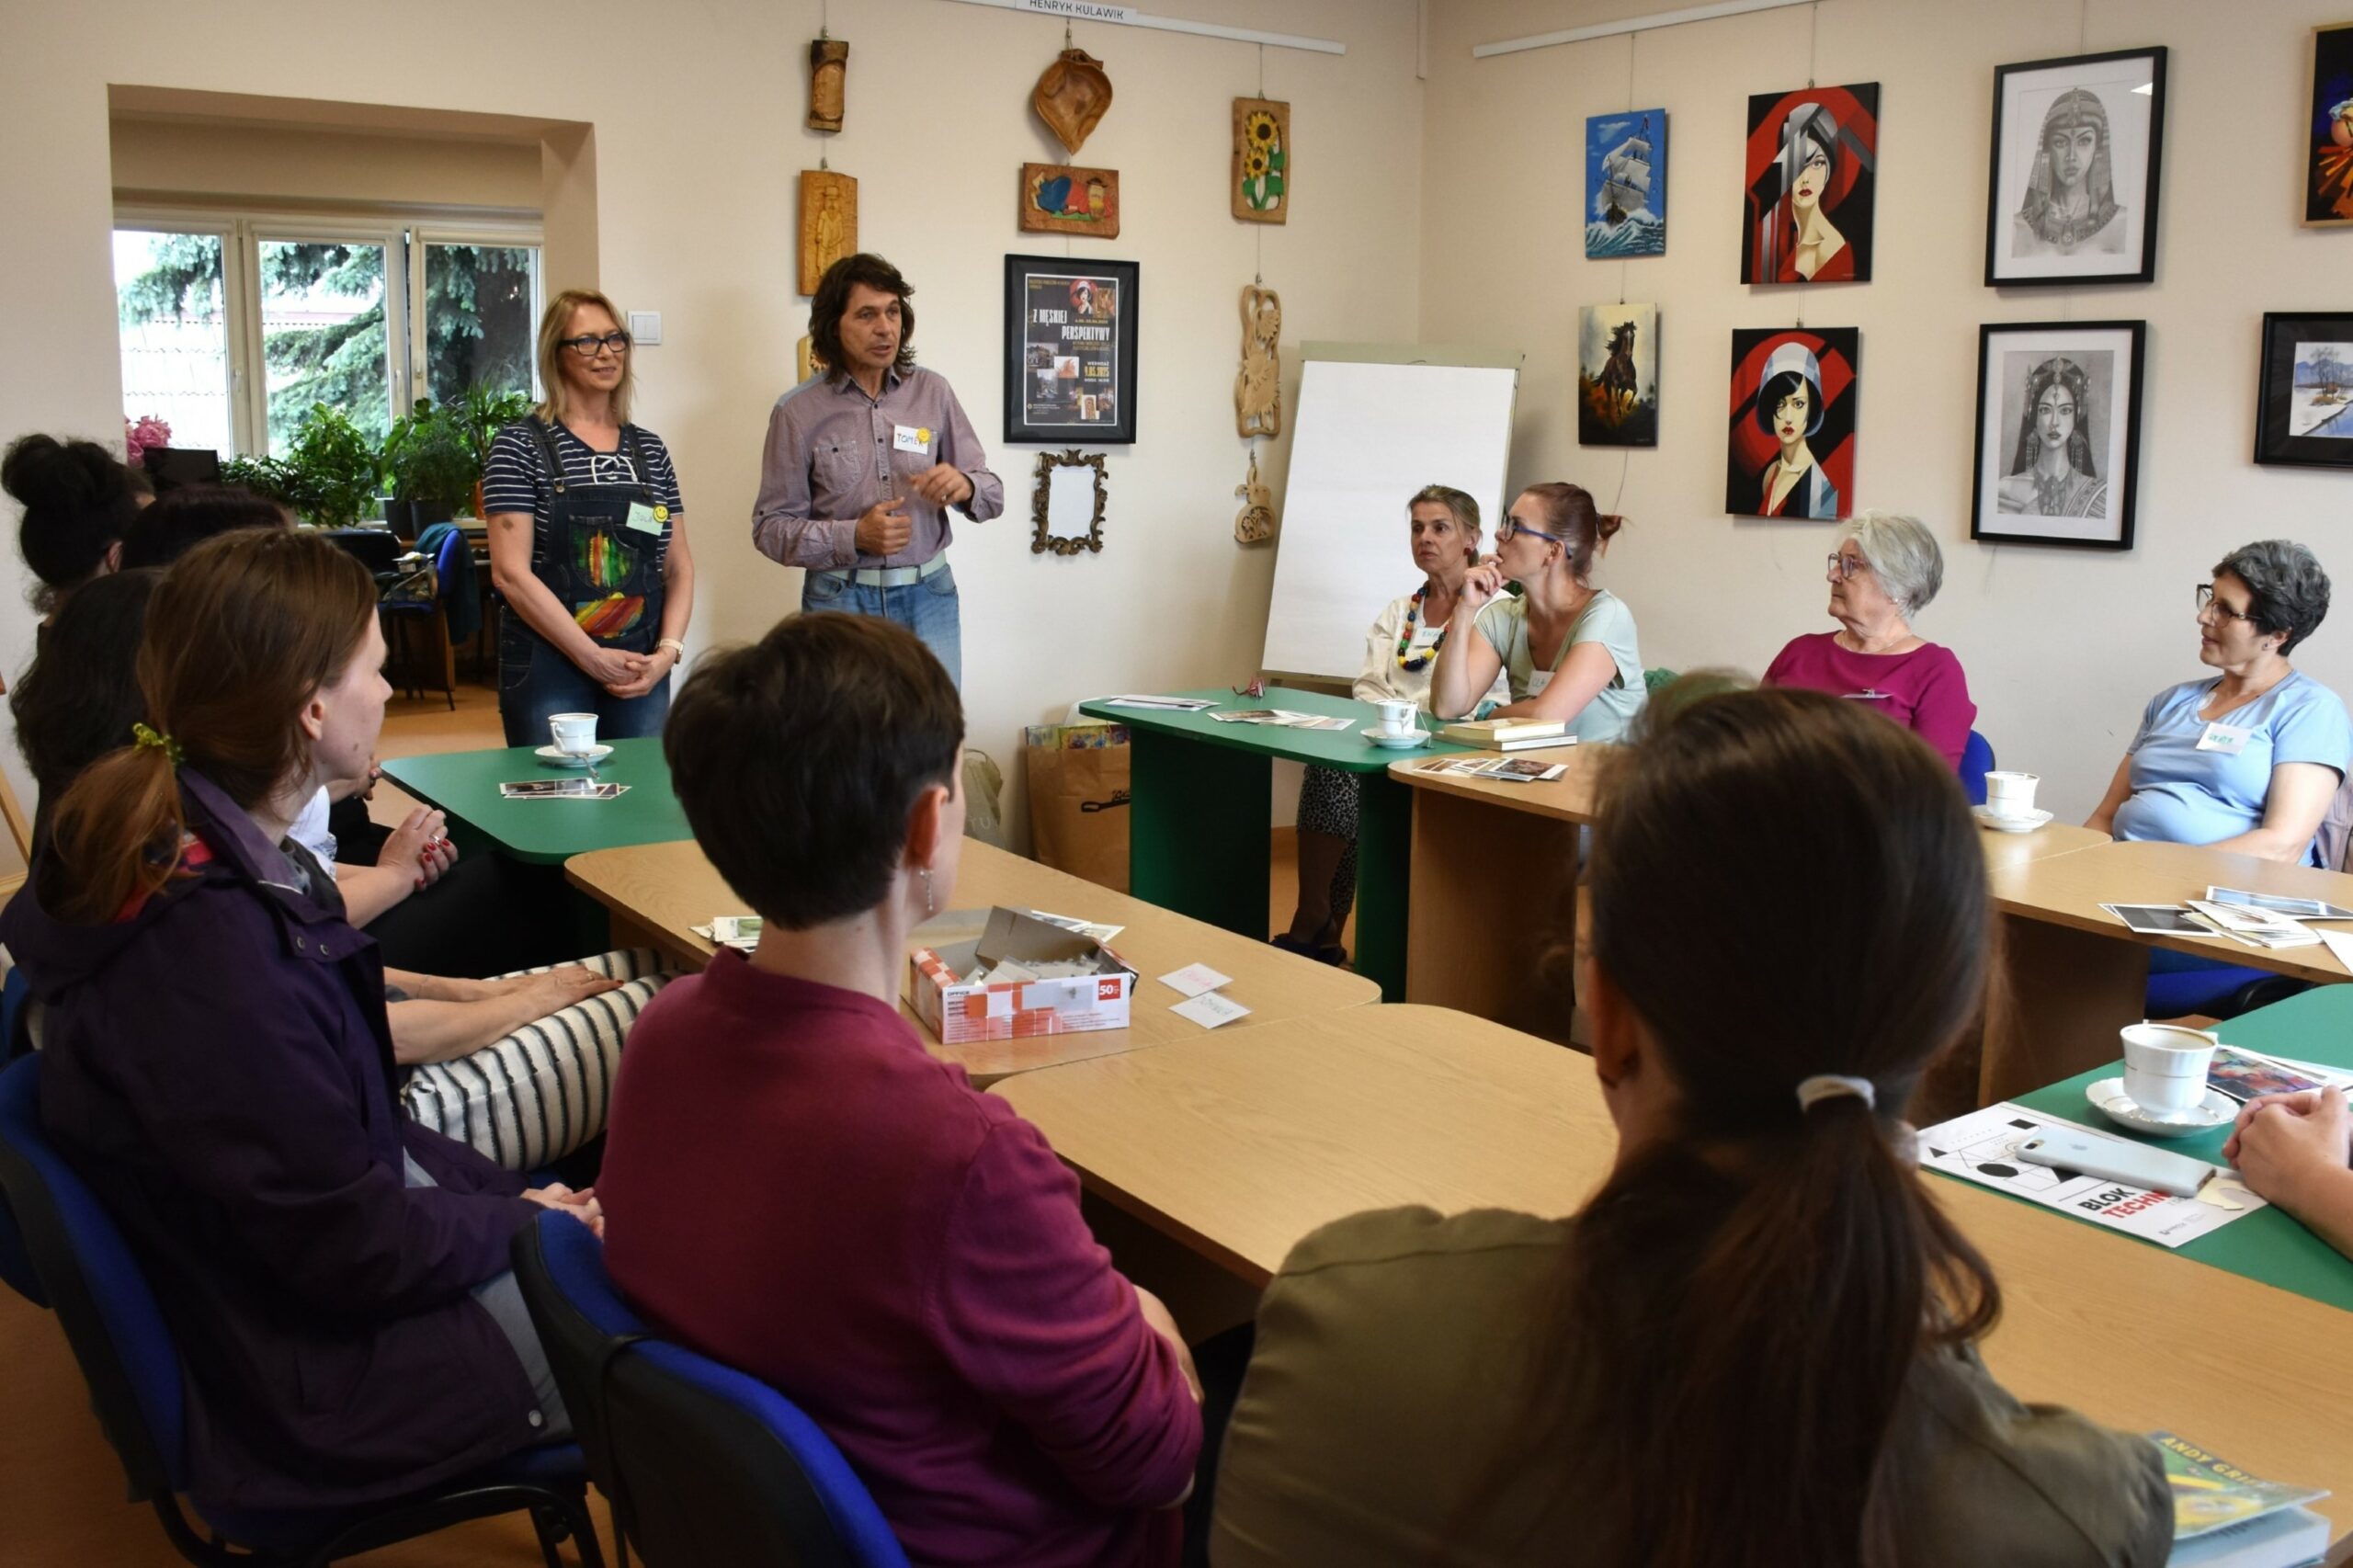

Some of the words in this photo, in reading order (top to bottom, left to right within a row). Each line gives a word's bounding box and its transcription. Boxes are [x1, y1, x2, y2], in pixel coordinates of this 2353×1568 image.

[1029, 0, 1073, 12] HENRYK
[1075, 4, 1124, 19] KULAWIK
[1032, 309, 1038, 324] Z
[1040, 309, 1068, 327] MĘSKIEJ
[1062, 325, 1110, 341] PERSPEKTYWY
[1099, 984, 1114, 996] 50
[2077, 1187, 2135, 1211] BLOK
[2159, 1437, 2214, 1463] ANDY
